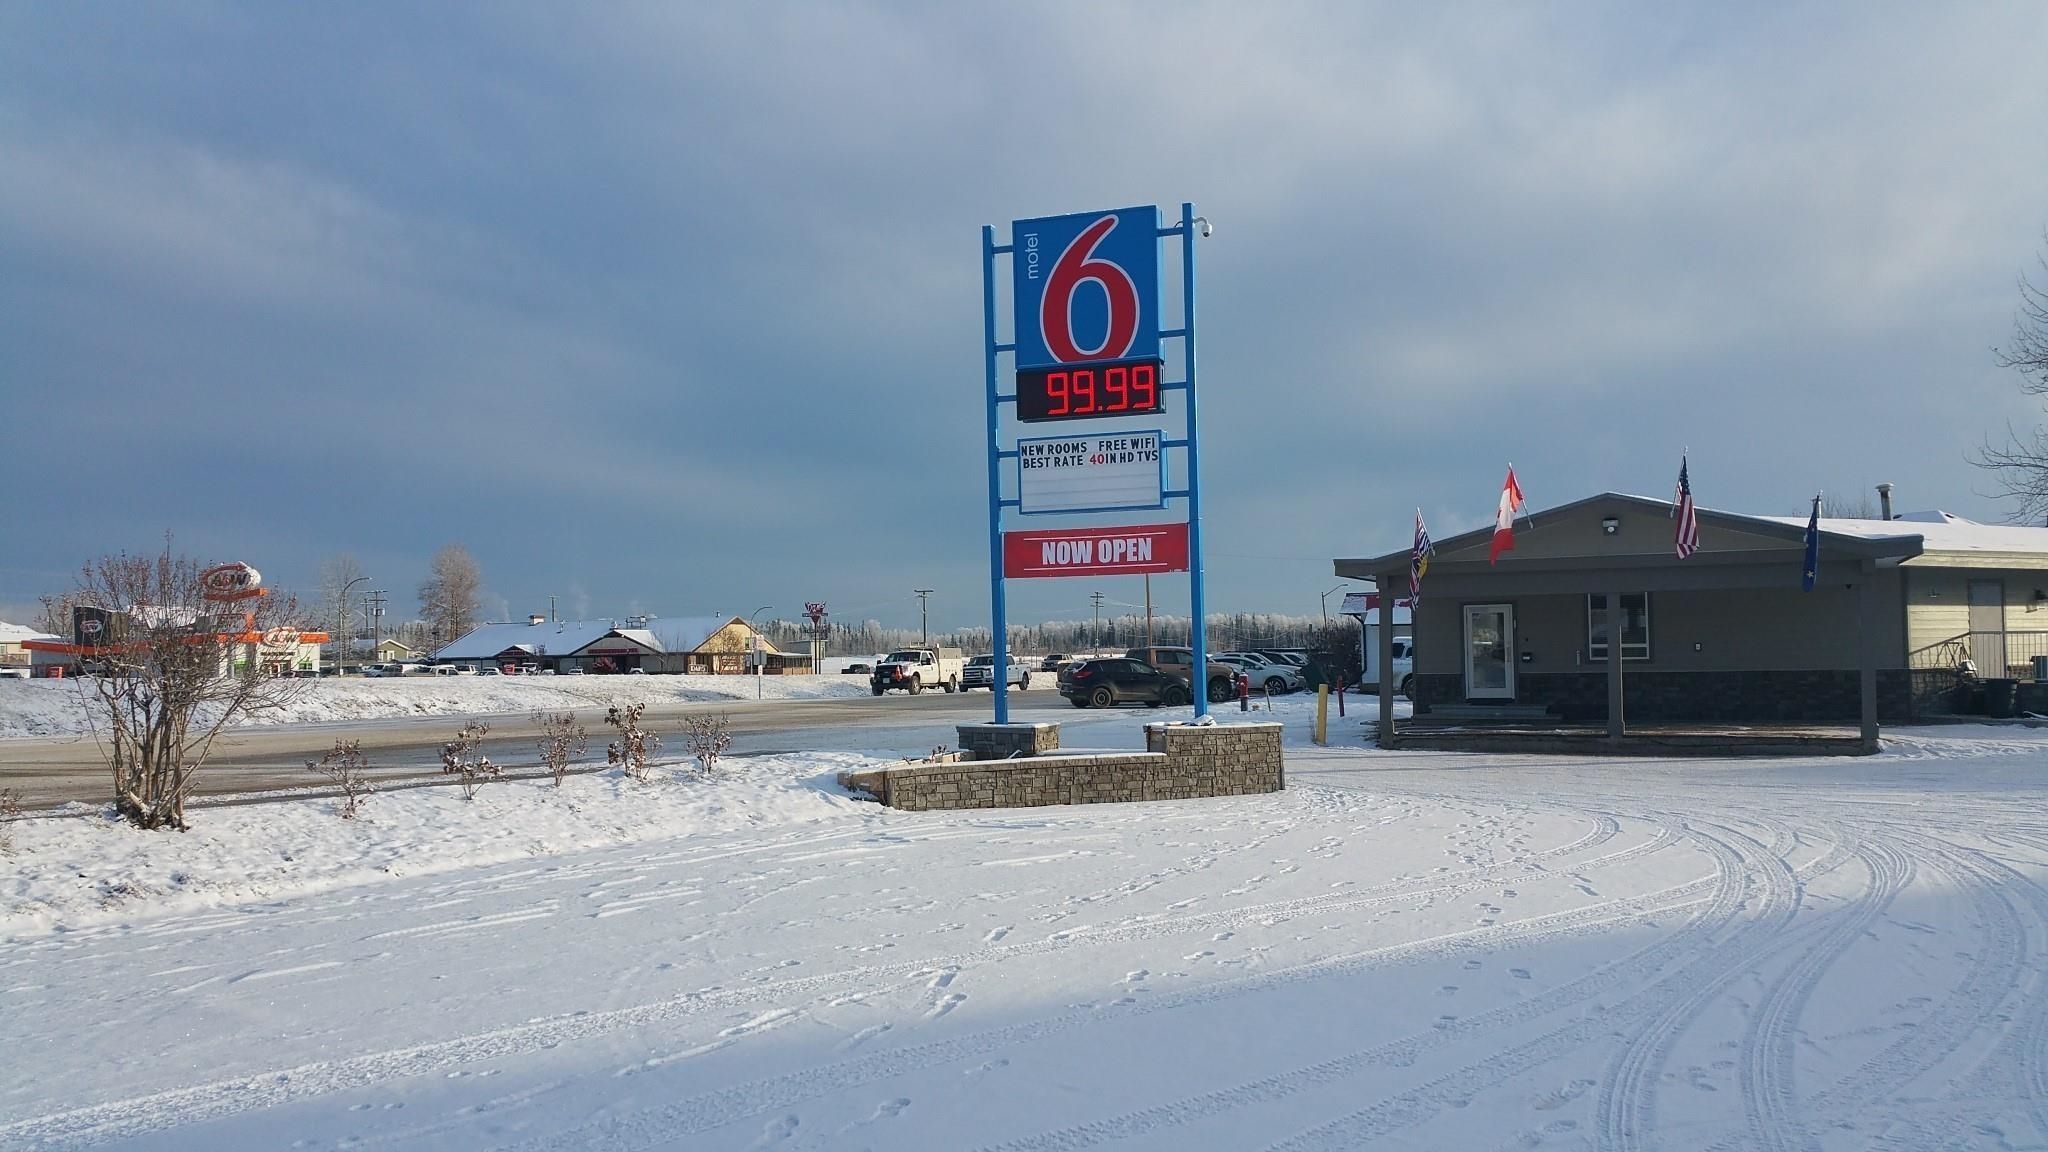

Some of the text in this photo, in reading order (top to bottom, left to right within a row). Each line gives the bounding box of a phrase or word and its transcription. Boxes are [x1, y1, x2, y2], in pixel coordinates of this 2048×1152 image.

[1024, 214, 1140, 363] motel 6
[1047, 365, 1154, 415] 99.99
[1021, 437, 1155, 456] NEW ROOMS FREE WIFI
[1023, 457, 1051, 469] BEST
[1054, 455, 1084, 468] RATE
[1120, 451, 1135, 463] HD
[1137, 450, 1159, 462] TVS
[1042, 537, 1152, 565] NOW OPEN
